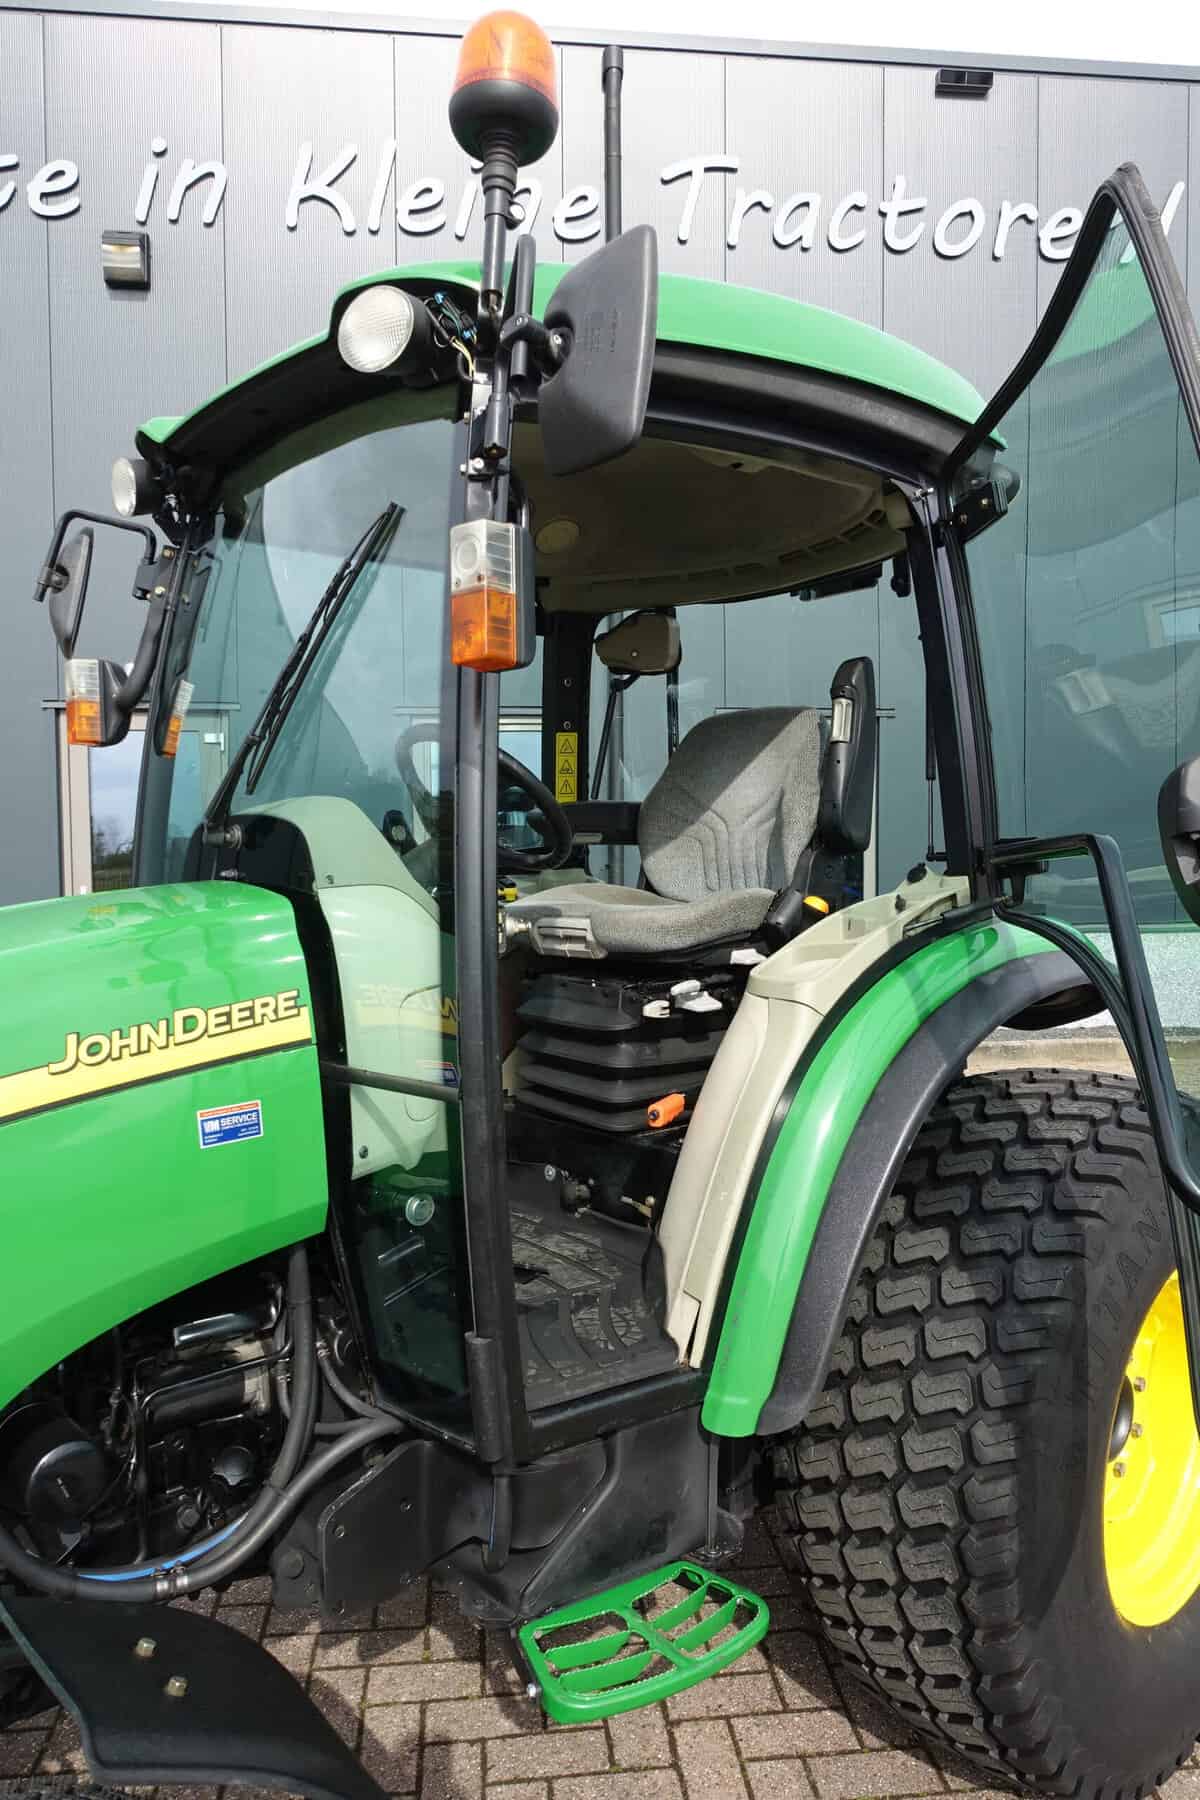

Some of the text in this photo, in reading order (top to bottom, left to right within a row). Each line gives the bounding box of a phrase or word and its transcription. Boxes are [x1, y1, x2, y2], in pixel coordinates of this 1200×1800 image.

[135, 137, 228, 226] in
[286, 137, 602, 245] Kleine
[49, 1019, 168, 1075] JOHN
[173, 989, 300, 1046] DEERE
[220, 1112, 257, 1127] SERVICE
